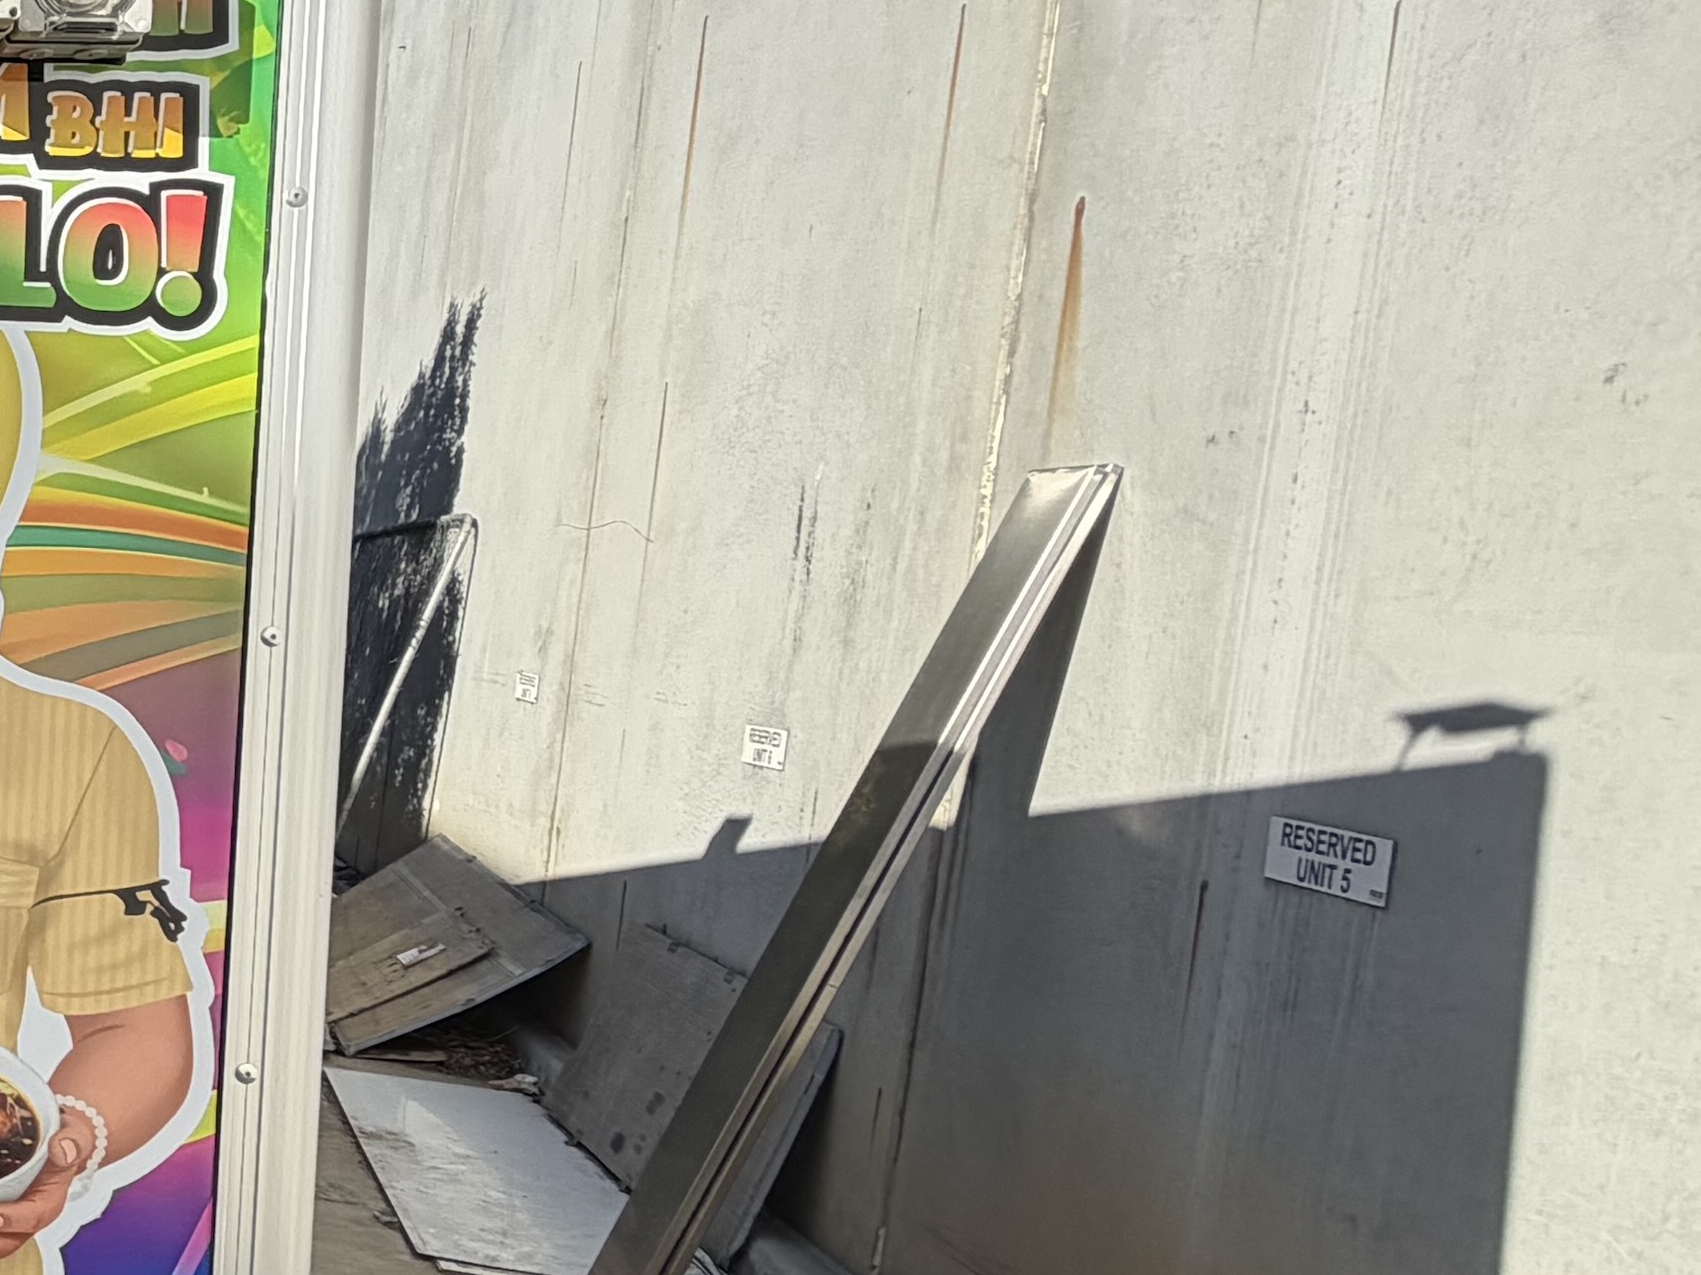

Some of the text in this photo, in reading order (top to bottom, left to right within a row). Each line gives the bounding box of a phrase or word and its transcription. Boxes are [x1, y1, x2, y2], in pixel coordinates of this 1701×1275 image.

[45, 90, 186, 160] BHI
[1280, 821, 1377, 867] RESERVED
[1296, 856, 1353, 894] UNIT 5
